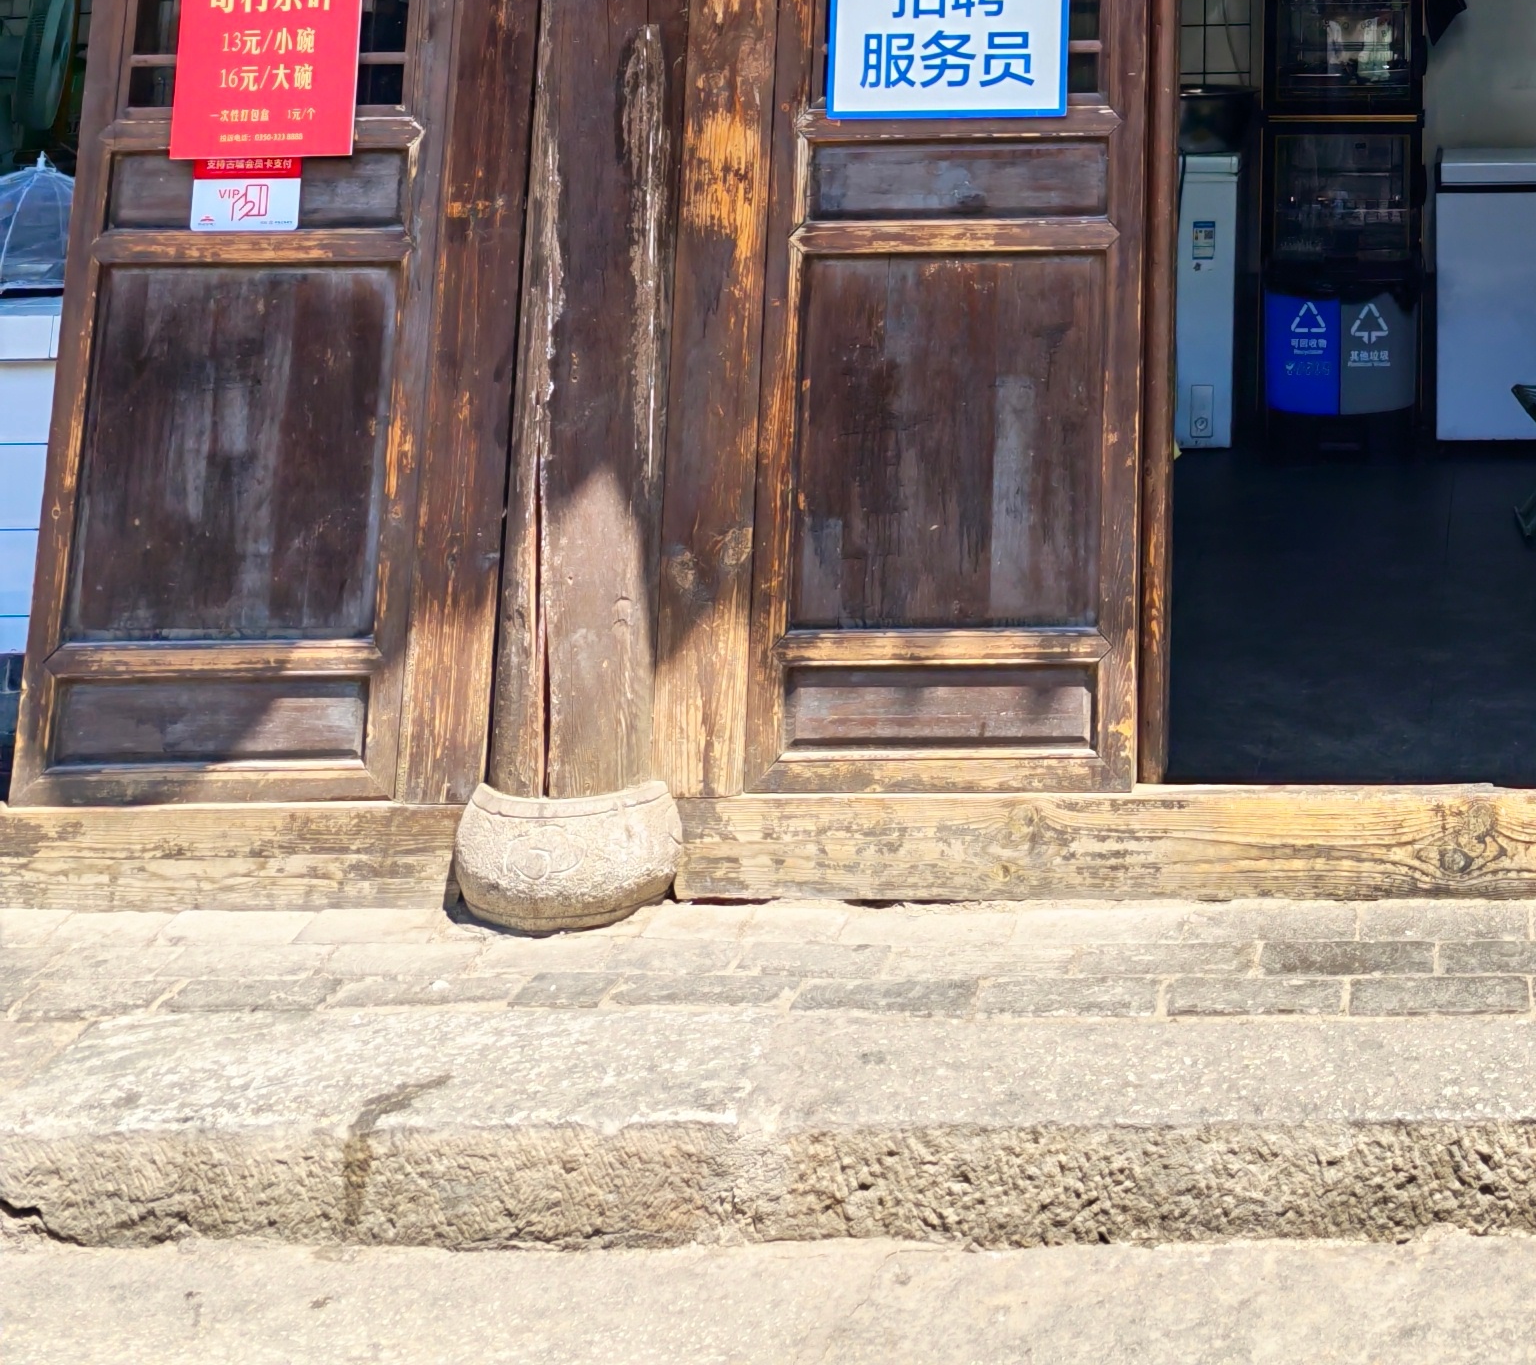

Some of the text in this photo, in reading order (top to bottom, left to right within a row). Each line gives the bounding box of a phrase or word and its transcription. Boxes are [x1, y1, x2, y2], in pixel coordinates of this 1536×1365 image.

[221, 26, 315, 55] 13元/小碗
[859, 29, 1035, 89] 服务员
[219, 64, 313, 91] 16元/大碗
[209, 107, 316, 122] 一次性打包盒 1元/个
[206, 158, 293, 170] 支持古城会员卡支付
[218, 188, 240, 199] VIP
[1290, 338, 1328, 349] 可回收物
[1349, 350, 1389, 362] 其他垃圾
